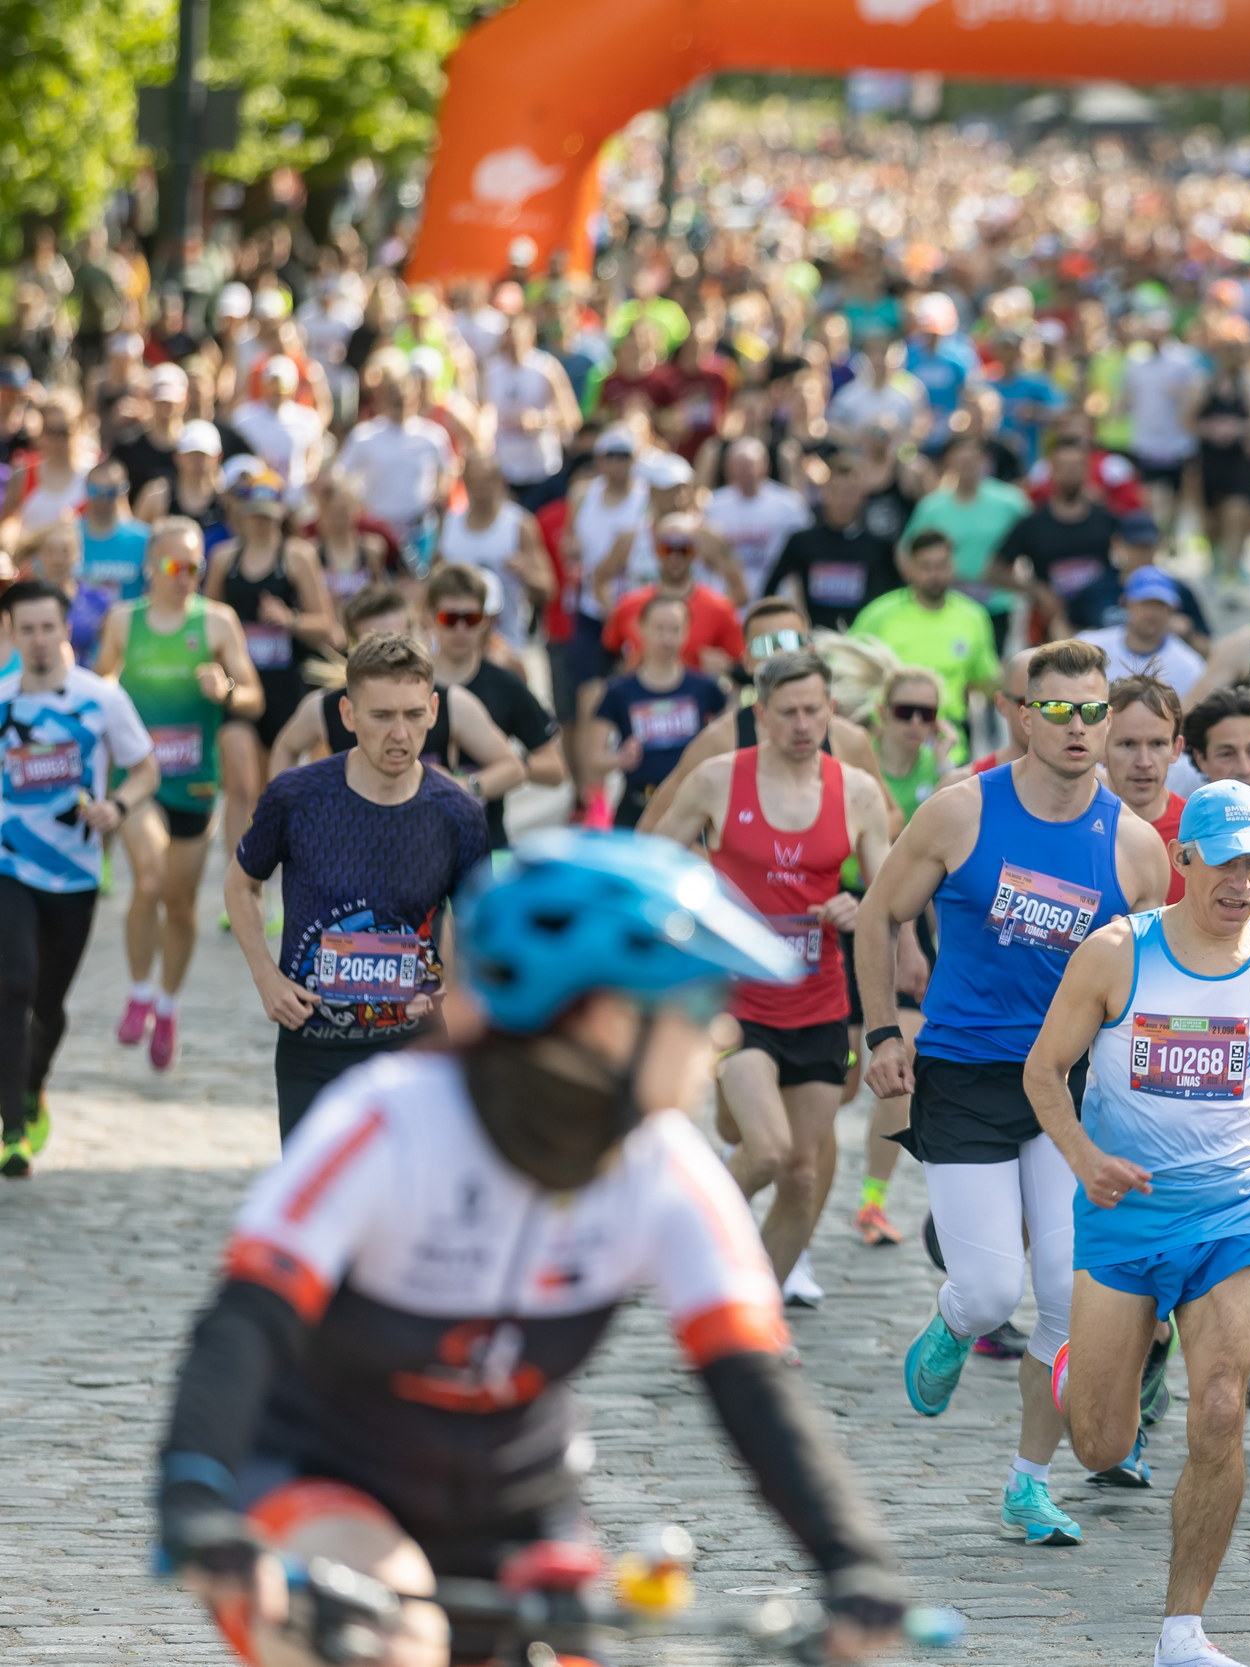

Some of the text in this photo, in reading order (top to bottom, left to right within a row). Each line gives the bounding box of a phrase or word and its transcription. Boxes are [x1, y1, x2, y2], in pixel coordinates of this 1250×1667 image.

[331, 898, 366, 917] RUN
[1011, 895, 1073, 933] 20059
[1024, 923, 1049, 940] TOMAS
[339, 957, 398, 983] 20546
[302, 1026, 364, 1039] NIKE
[1157, 1046, 1224, 1075] 10268
[1176, 1075, 1200, 1087] LINAS
